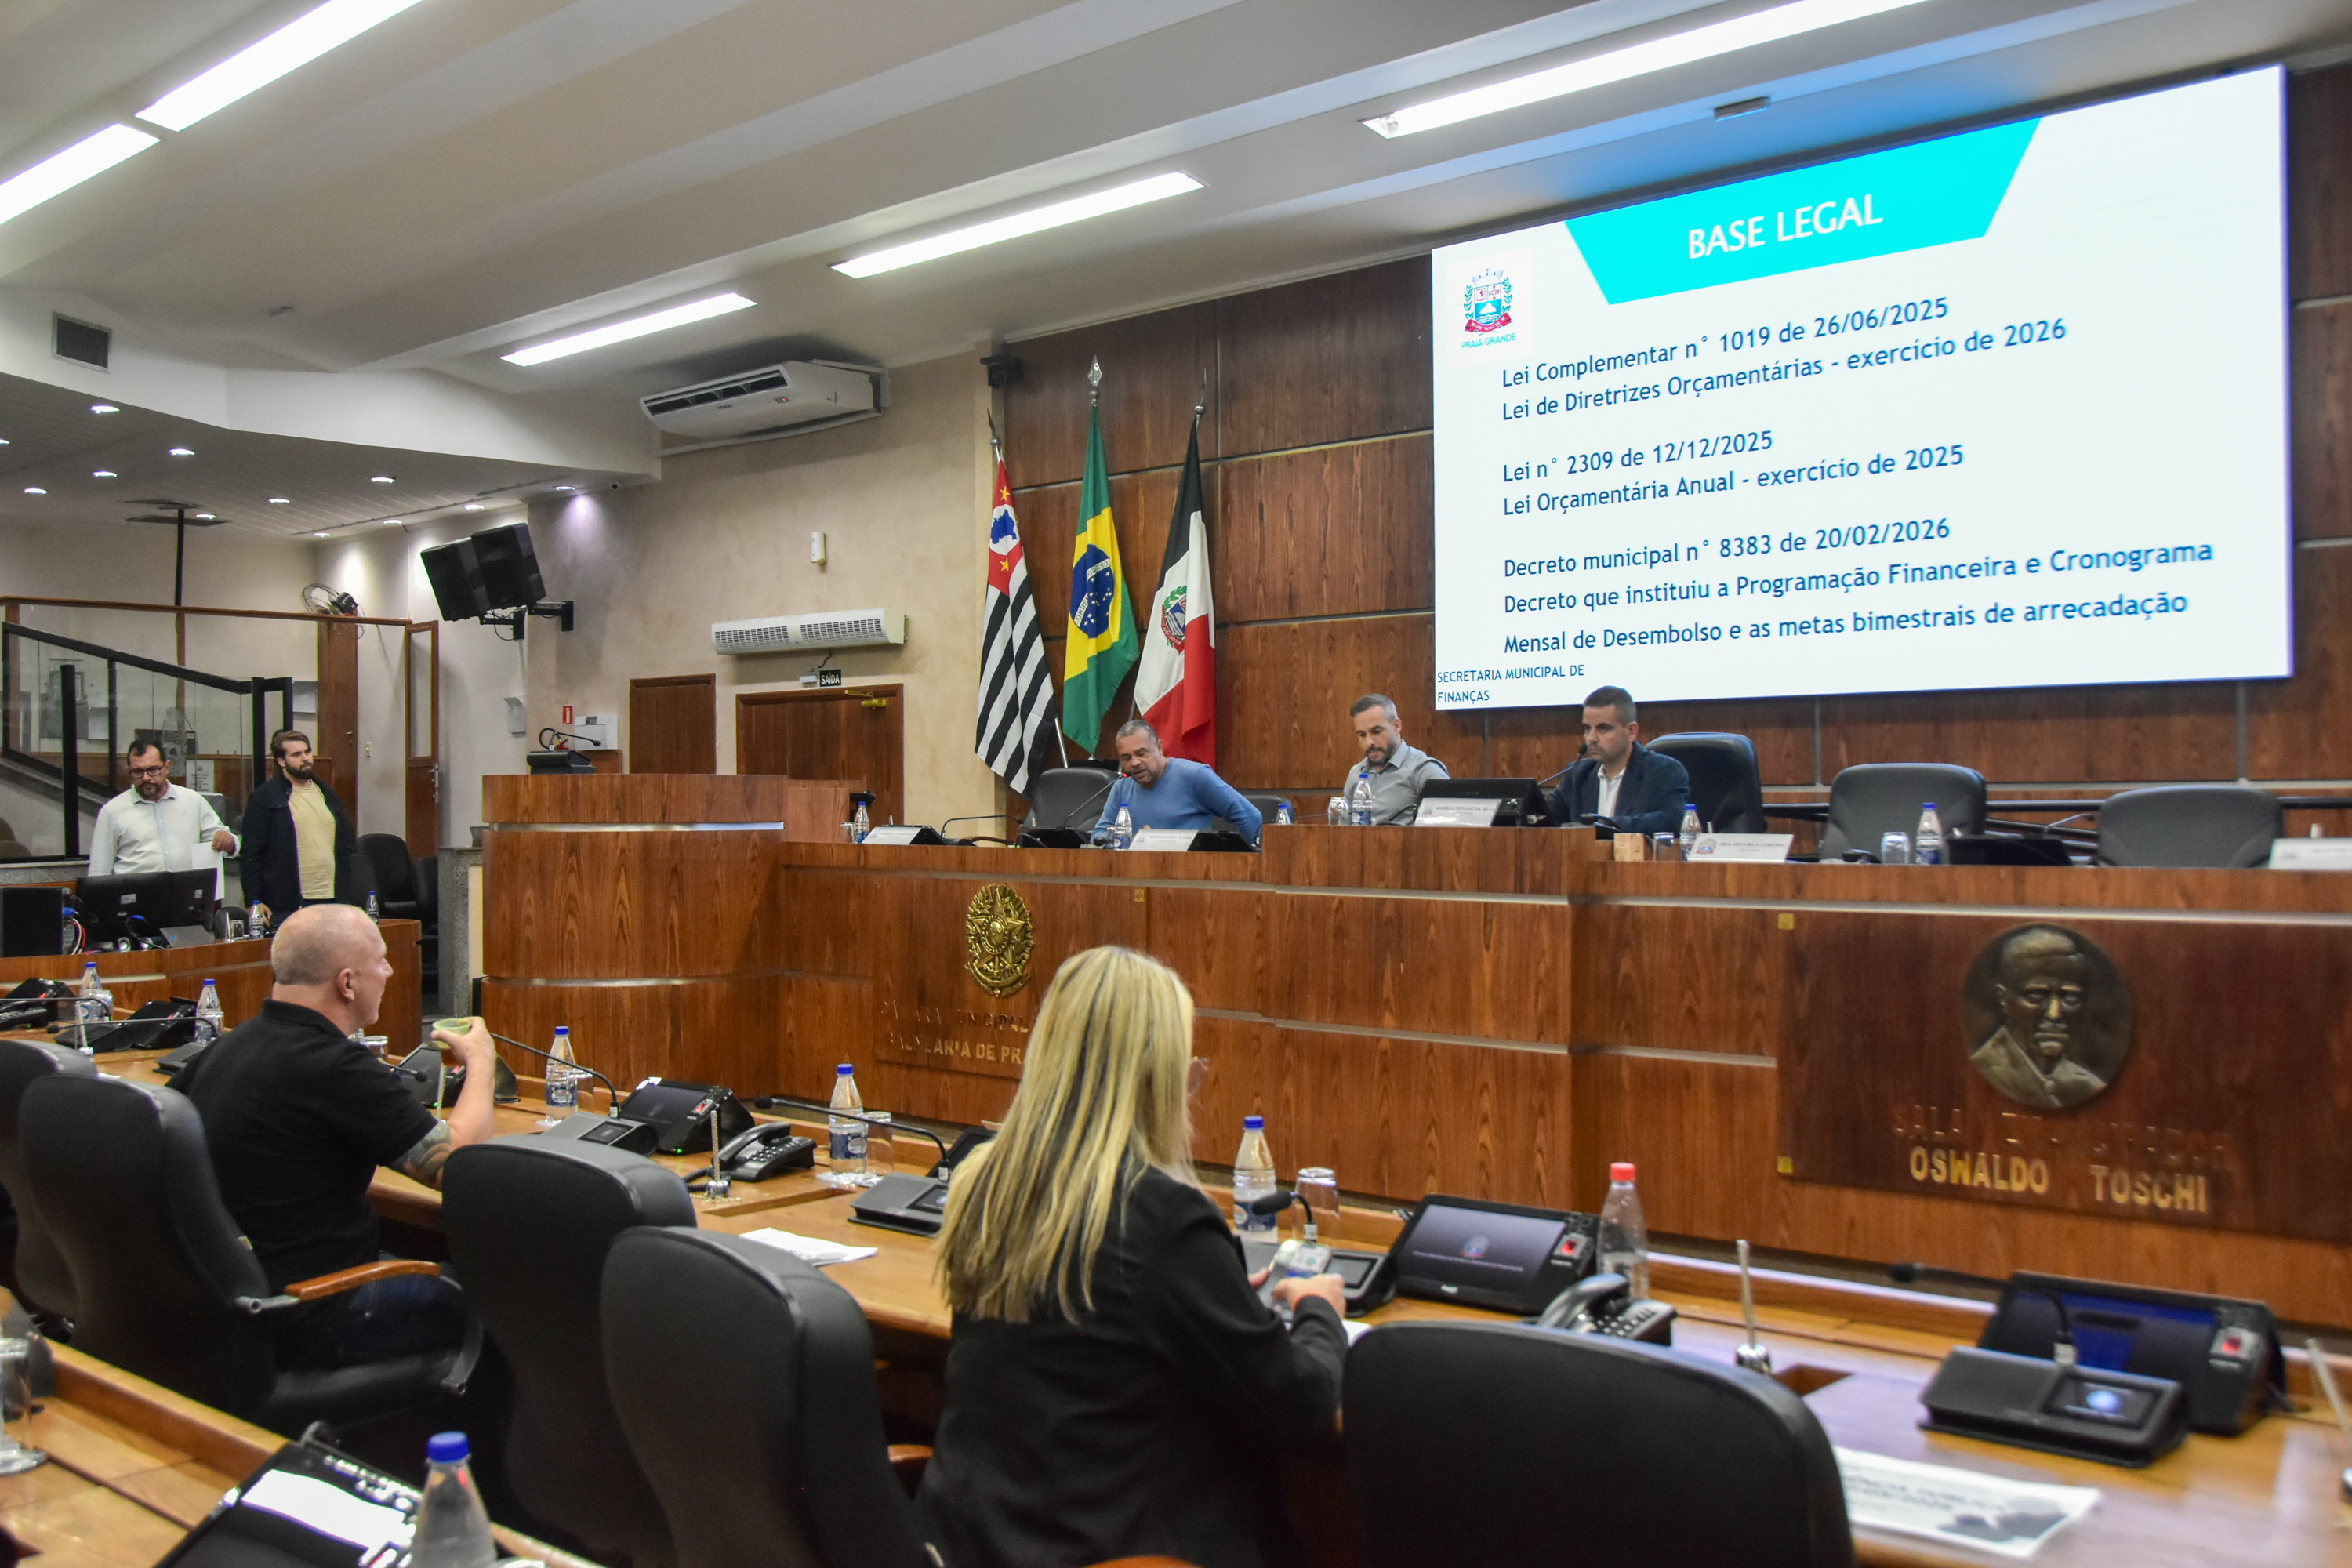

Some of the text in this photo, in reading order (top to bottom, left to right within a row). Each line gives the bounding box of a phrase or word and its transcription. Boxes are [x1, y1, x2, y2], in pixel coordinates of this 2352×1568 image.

[1688, 194, 1884, 260] BASE LEGAL
[1461, 332, 1515, 349] PRAIA GRANDE
[1502, 365, 1530, 387] Lei
[1535, 345, 1679, 382] Complementar
[1719, 325, 1771, 352] 1019
[1778, 321, 1806, 343] de
[1813, 296, 1948, 338] 26/06/2025
[1502, 398, 1530, 421] Lei
[1535, 395, 1559, 416] de
[1565, 383, 1661, 412] Diretrizes
[1667, 357, 1824, 398] Orçamentárias
[1846, 336, 1956, 369] exercício
[1963, 329, 1994, 352] de
[2004, 317, 2067, 347] 2026
[1503, 460, 1530, 482] Lei
[1566, 449, 1613, 474] 2309
[1620, 446, 1645, 467] de
[1653, 429, 1773, 463] 12/12/2025
[1503, 494, 1530, 516] Lei
[1536, 479, 1669, 514] Orçamentária
[1675, 470, 1735, 496] Anual
[1756, 457, 1860, 487] exercício
[1867, 452, 1896, 474] de
[1904, 443, 1964, 470] 2025
[1504, 554, 1577, 577] Decreto
[1583, 542, 1679, 571] municipal
[1719, 533, 1772, 558] 8383
[1779, 531, 1807, 553] de
[1814, 517, 1951, 550] 20/02/2026
[1504, 543, 2214, 613] Decreto que instituiu a Programação Financeira e Cronograma
[1503, 590, 2188, 654] Mensal de Desembolso e as metas bimestrais de arrecadação
[821, 673, 840, 684] SAÍDA
[1436, 663, 1585, 683] SECRETARIA MUNICIPAL DE
[1437, 689, 1490, 705] FINANÇAS
[976, 1043, 996, 1062] DE
[1909, 1145, 2049, 1195] OSWALDO
[2089, 1164, 2209, 1213] TOSCHI
